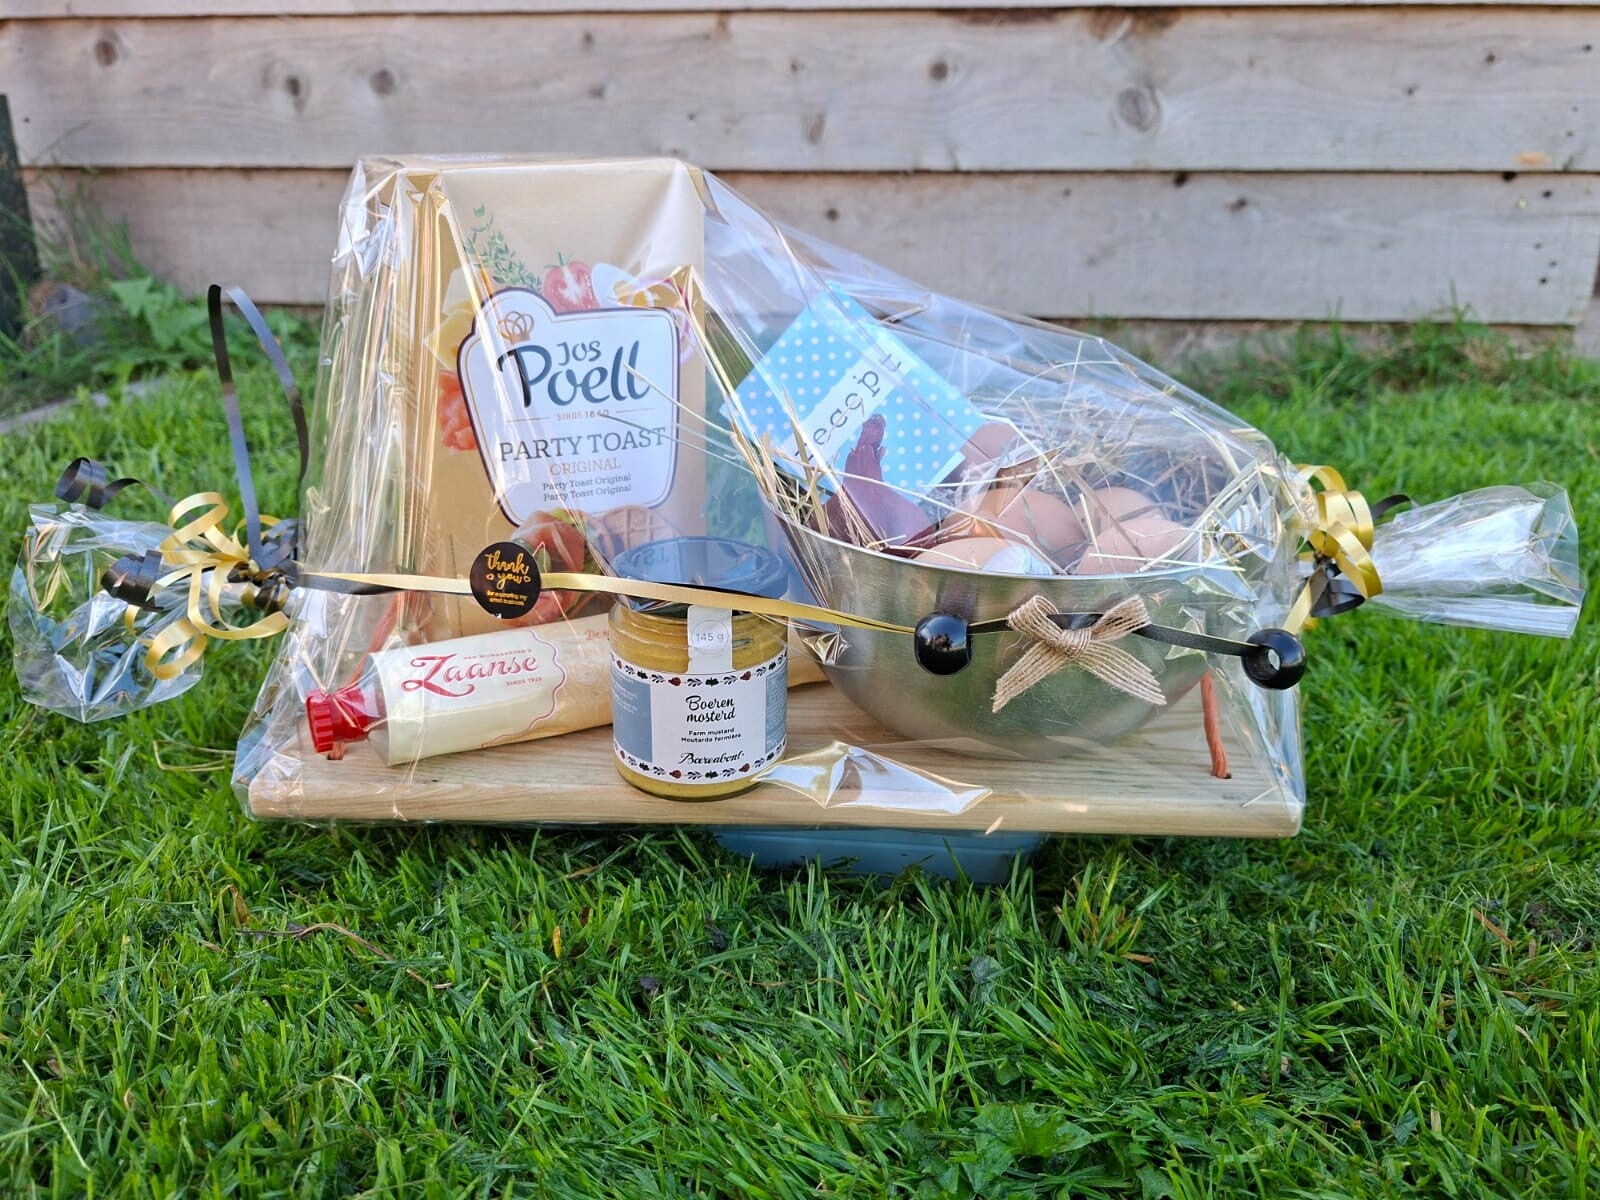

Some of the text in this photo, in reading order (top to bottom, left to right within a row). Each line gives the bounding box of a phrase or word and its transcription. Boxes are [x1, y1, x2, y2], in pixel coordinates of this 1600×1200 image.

[557, 340, 602, 366] Jos
[496, 340, 651, 408] Poell
[498, 426, 667, 462] PARTY TOAST
[549, 457, 622, 477] ORIGINAL
[543, 473, 632, 491] Party Toast Original
[543, 484, 632, 502] Party Toast Original
[485, 550, 530, 575] thank
[496, 572, 523, 590] you
[695, 632, 724, 642] 145 g
[400, 652, 539, 697] Zaanse
[685, 694, 736, 711] Boeren
[686, 707, 736, 723] mosterd
[708, 727, 735, 735] mustard
